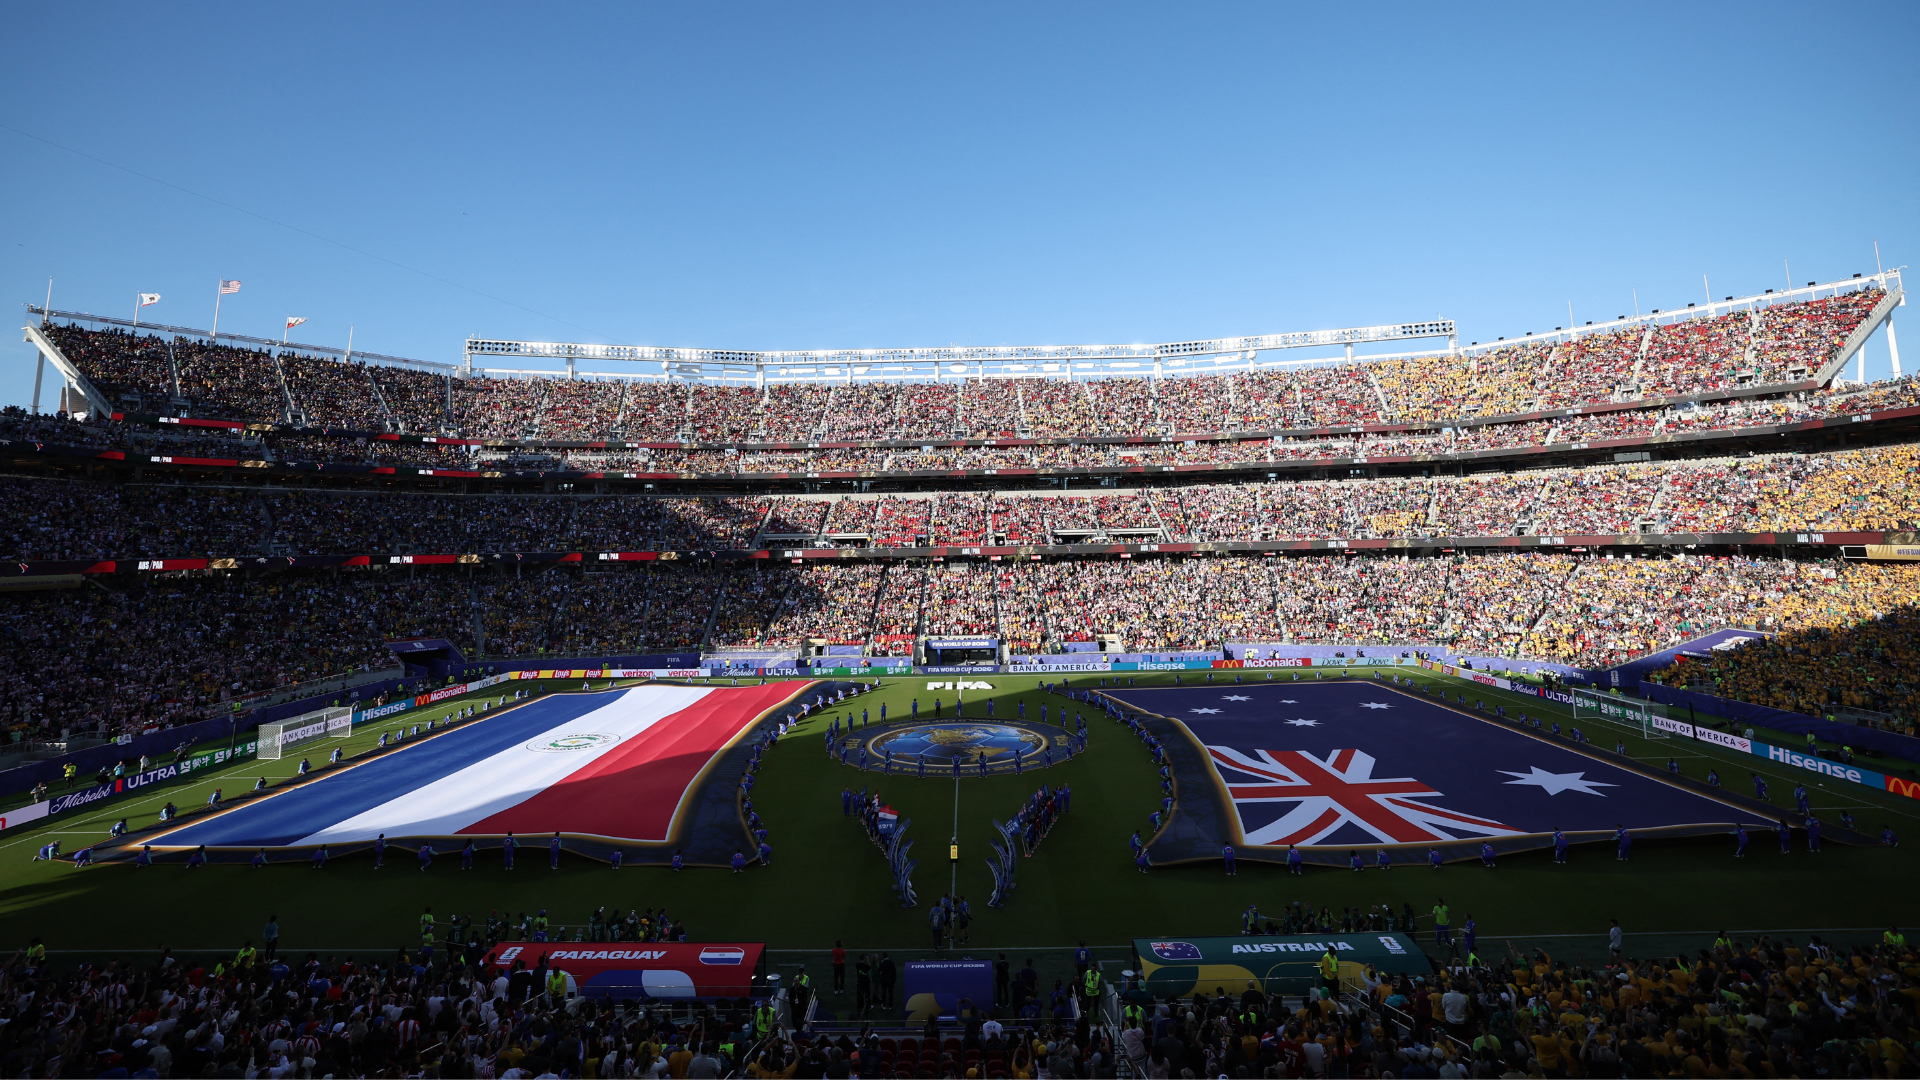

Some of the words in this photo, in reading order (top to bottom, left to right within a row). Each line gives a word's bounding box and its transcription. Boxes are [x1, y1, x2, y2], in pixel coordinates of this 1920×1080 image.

[1055, 663, 1098, 671] AMERICA
[1138, 661, 1186, 670] Hisense
[1243, 658, 1303, 667] McDonald's
[622, 669, 654, 677] verizon
[668, 669, 700, 677] verizon
[766, 668, 799, 676] ULTRA
[926, 681, 993, 690] FIFA
[1472, 674, 1497, 687] verizon
[430, 685, 467, 702] McDonald's
[1545, 691, 1574, 705] ULTRA
[361, 702, 406, 722] Hisense
[1655, 718, 1677, 731] BANK
[1680, 724, 1690, 735] OF
[1769, 745, 1862, 783] Hisense
[127, 764, 178, 790] ULTRA
[1232, 941, 1354, 954] AUSTRALIA
[549, 950, 667, 960] PARAGUAY
